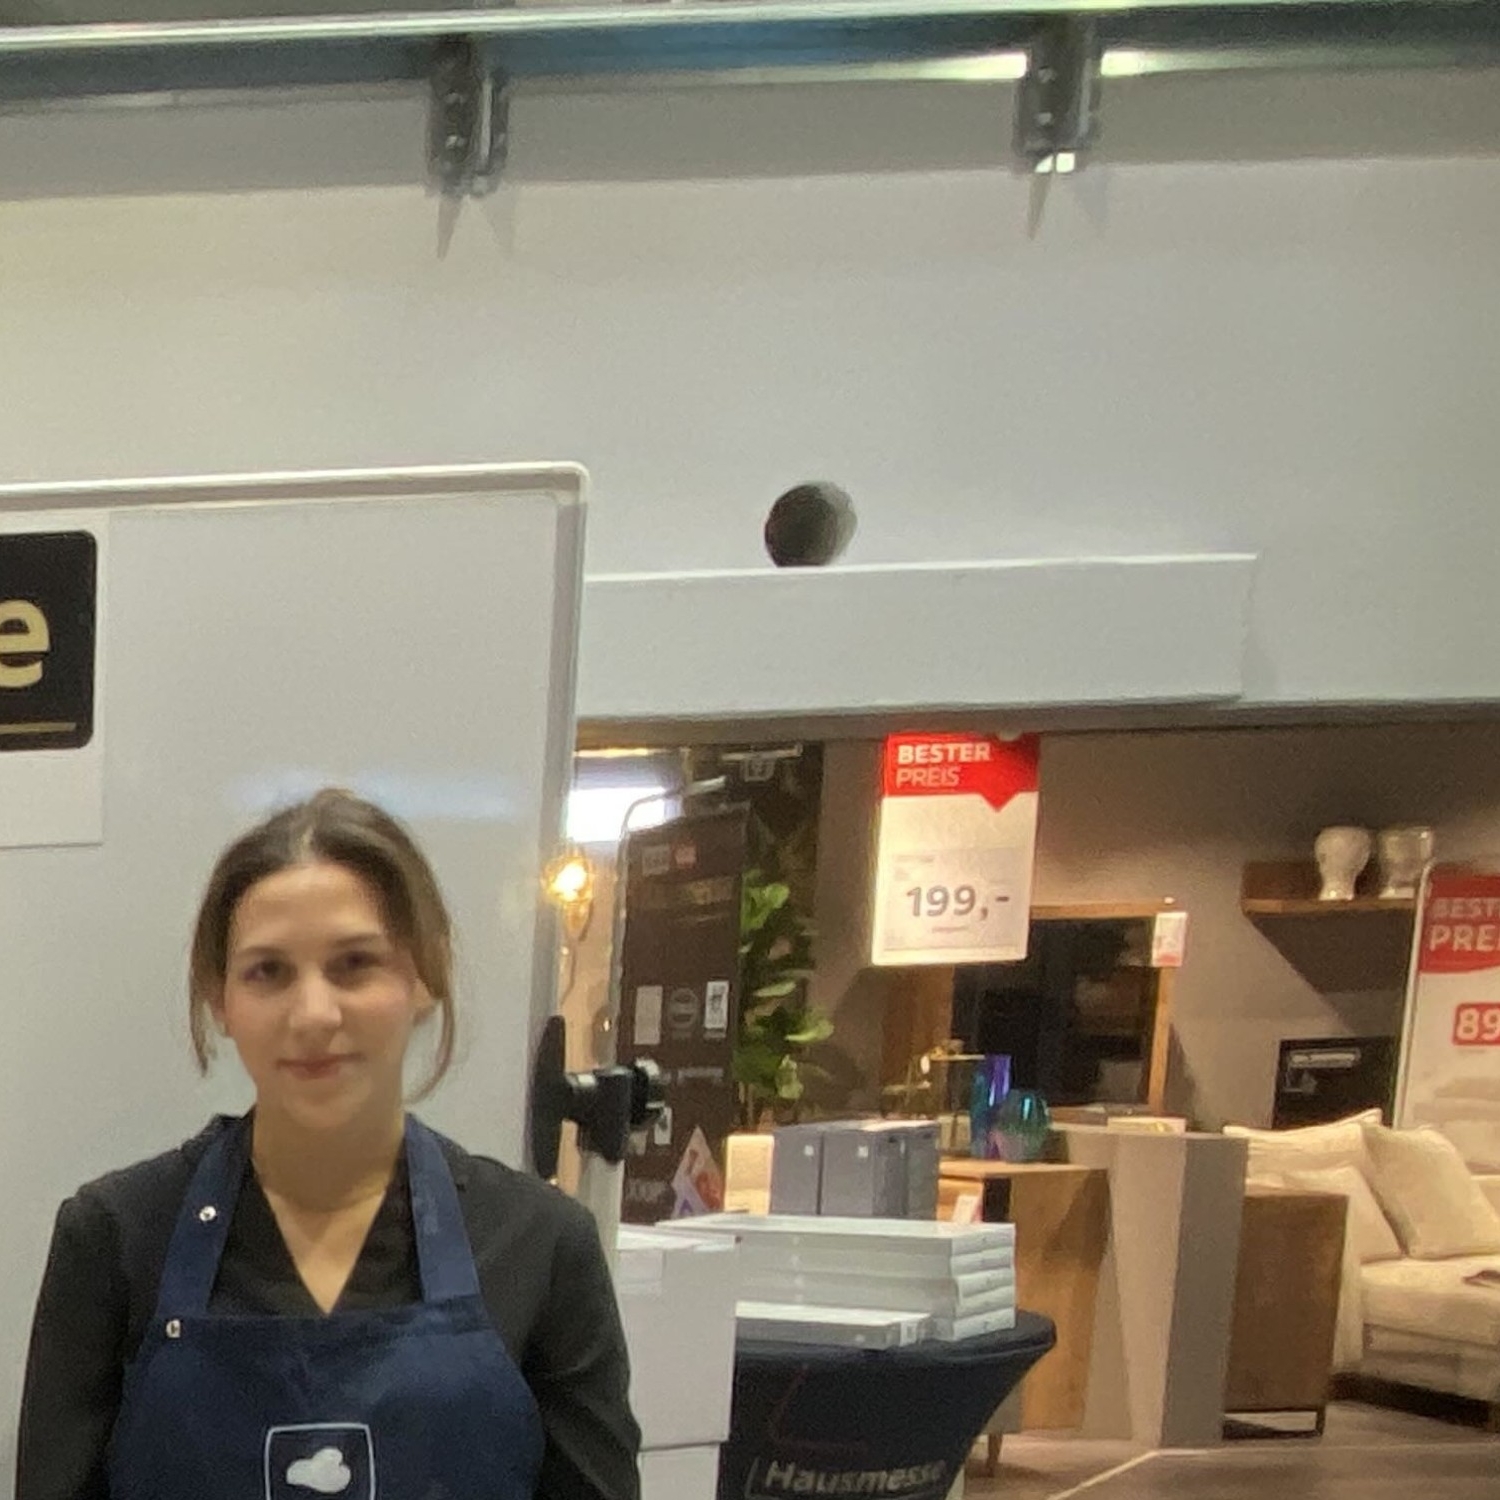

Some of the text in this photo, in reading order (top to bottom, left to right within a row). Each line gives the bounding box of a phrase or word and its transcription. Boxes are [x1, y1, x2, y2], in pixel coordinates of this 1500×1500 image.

[897, 742, 991, 764] BESTER
[895, 765, 961, 788] PREIS
[906, 884, 1010, 921] 199,-
[1433, 897, 1500, 919] BEST
[1457, 1007, 1500, 1041] 89
